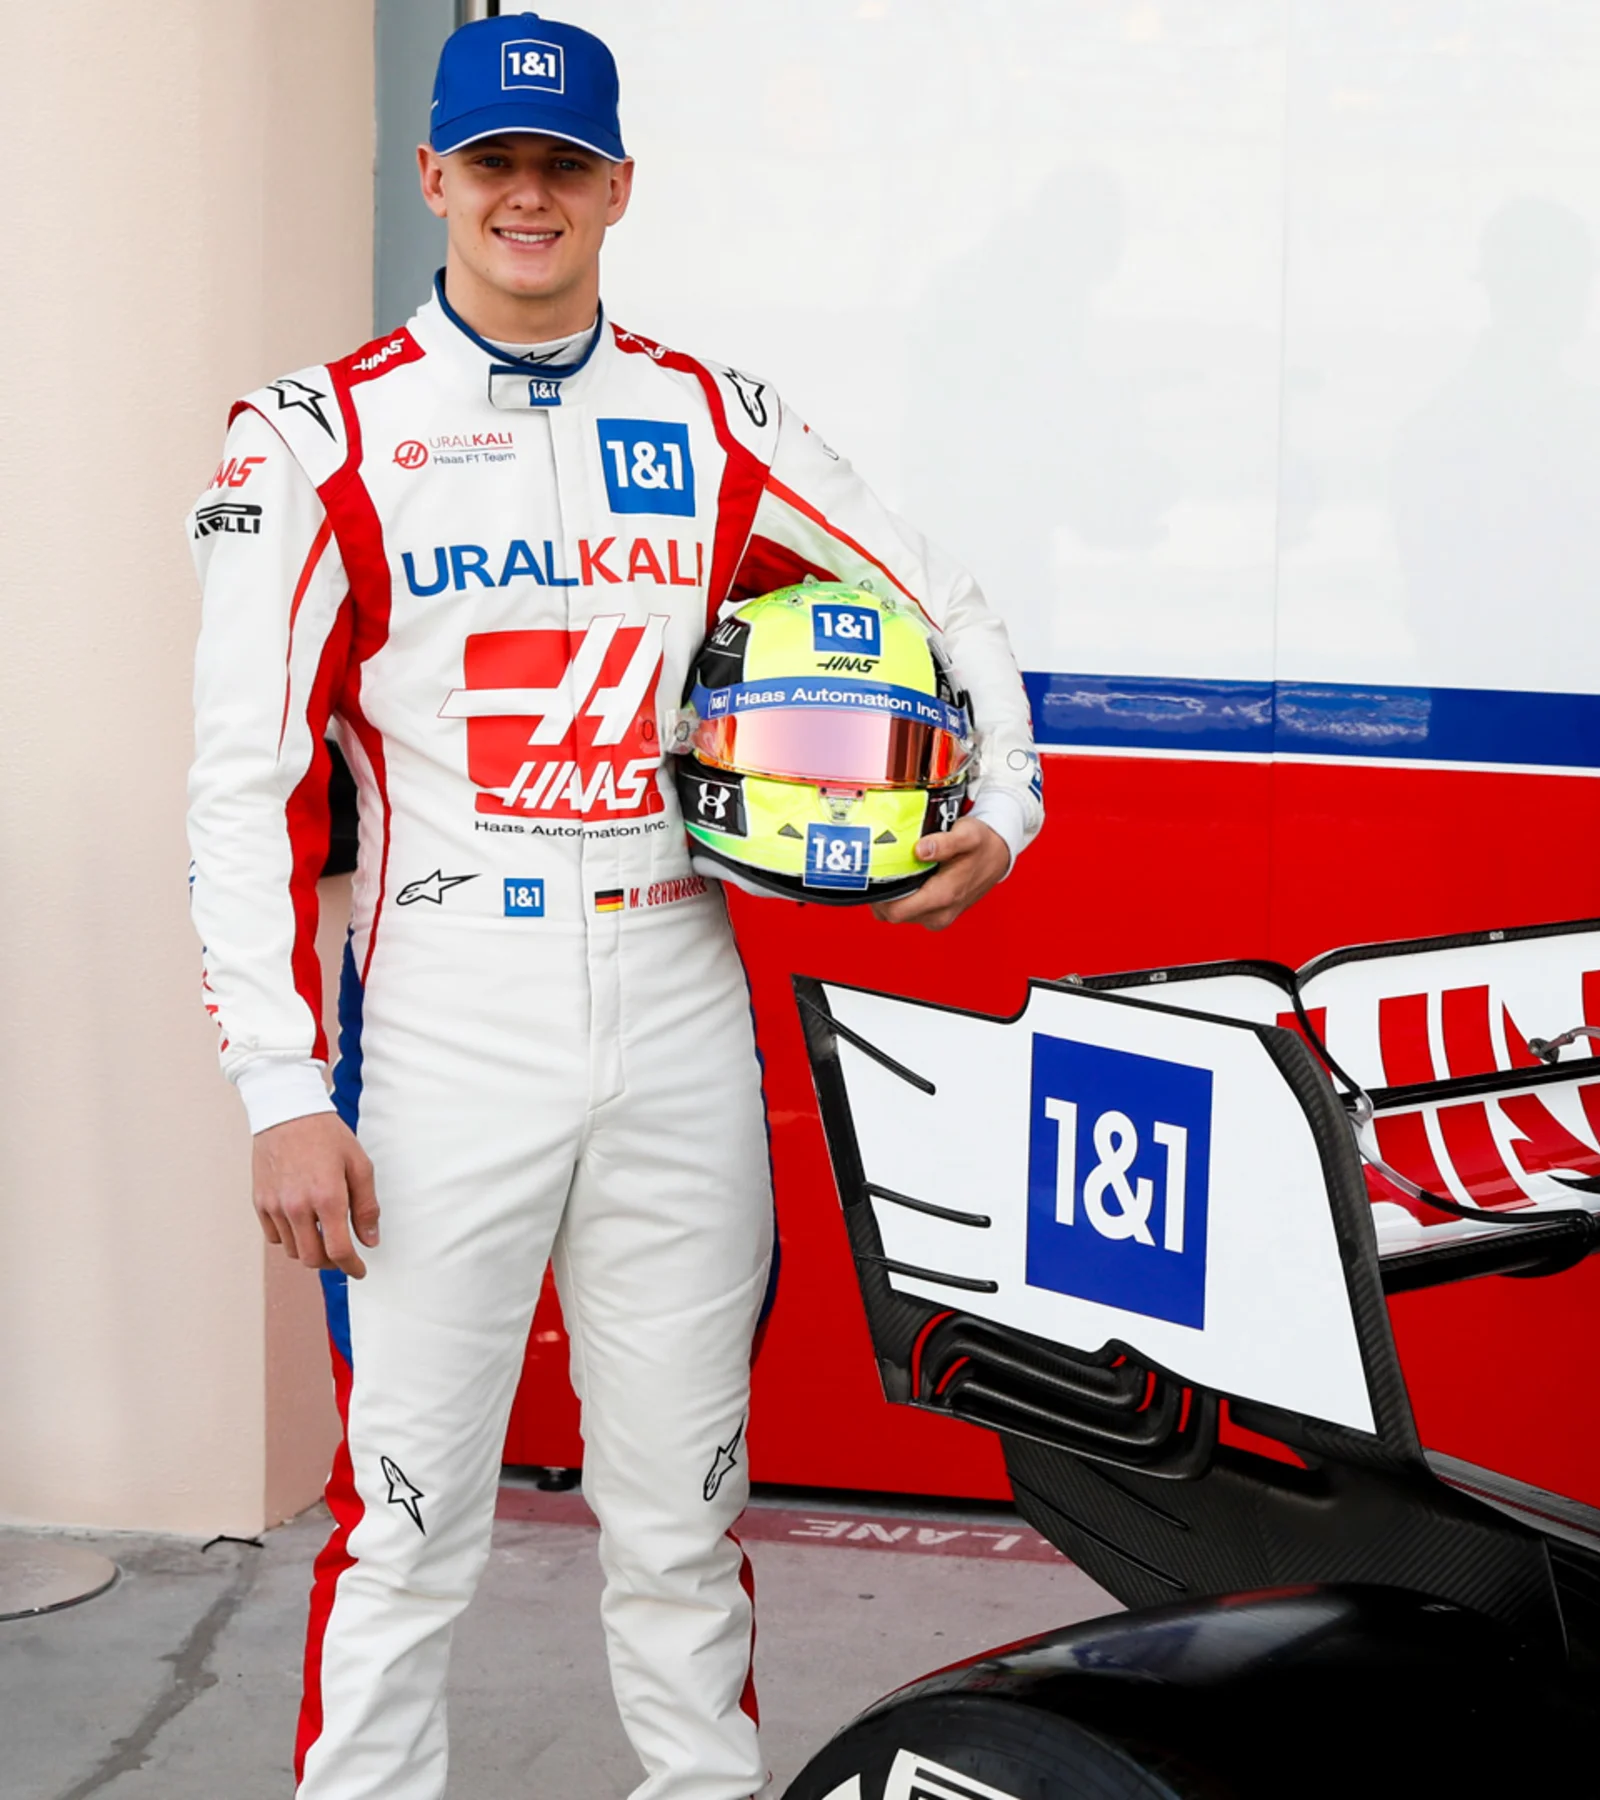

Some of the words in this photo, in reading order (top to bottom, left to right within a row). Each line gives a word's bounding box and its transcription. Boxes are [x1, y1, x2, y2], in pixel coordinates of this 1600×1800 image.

[508, 50, 557, 79] 1&1
[352, 337, 405, 371] HAAS
[531, 381, 559, 399] 1&1
[429, 432, 514, 449] URALKALI
[433, 454, 464, 465] Haas
[466, 453, 480, 464] F1
[483, 451, 517, 463] Team
[606, 440, 685, 491] 1&1
[402, 536, 703, 598] URALKALI
[817, 611, 875, 642] 1&1
[816, 656, 880, 673] HAAS
[735, 688, 785, 706] Haas
[791, 687, 911, 712] Automation
[916, 701, 943, 721] Inc.
[476, 756, 666, 812] HAAS
[474, 820, 526, 834] Haas
[644, 819, 670, 834] Inc.
[812, 837, 864, 873] 1&1
[507, 886, 541, 908] 1&1
[1043, 1094, 1188, 1255] 1&1
[789, 1518, 1023, 1552] LANE
